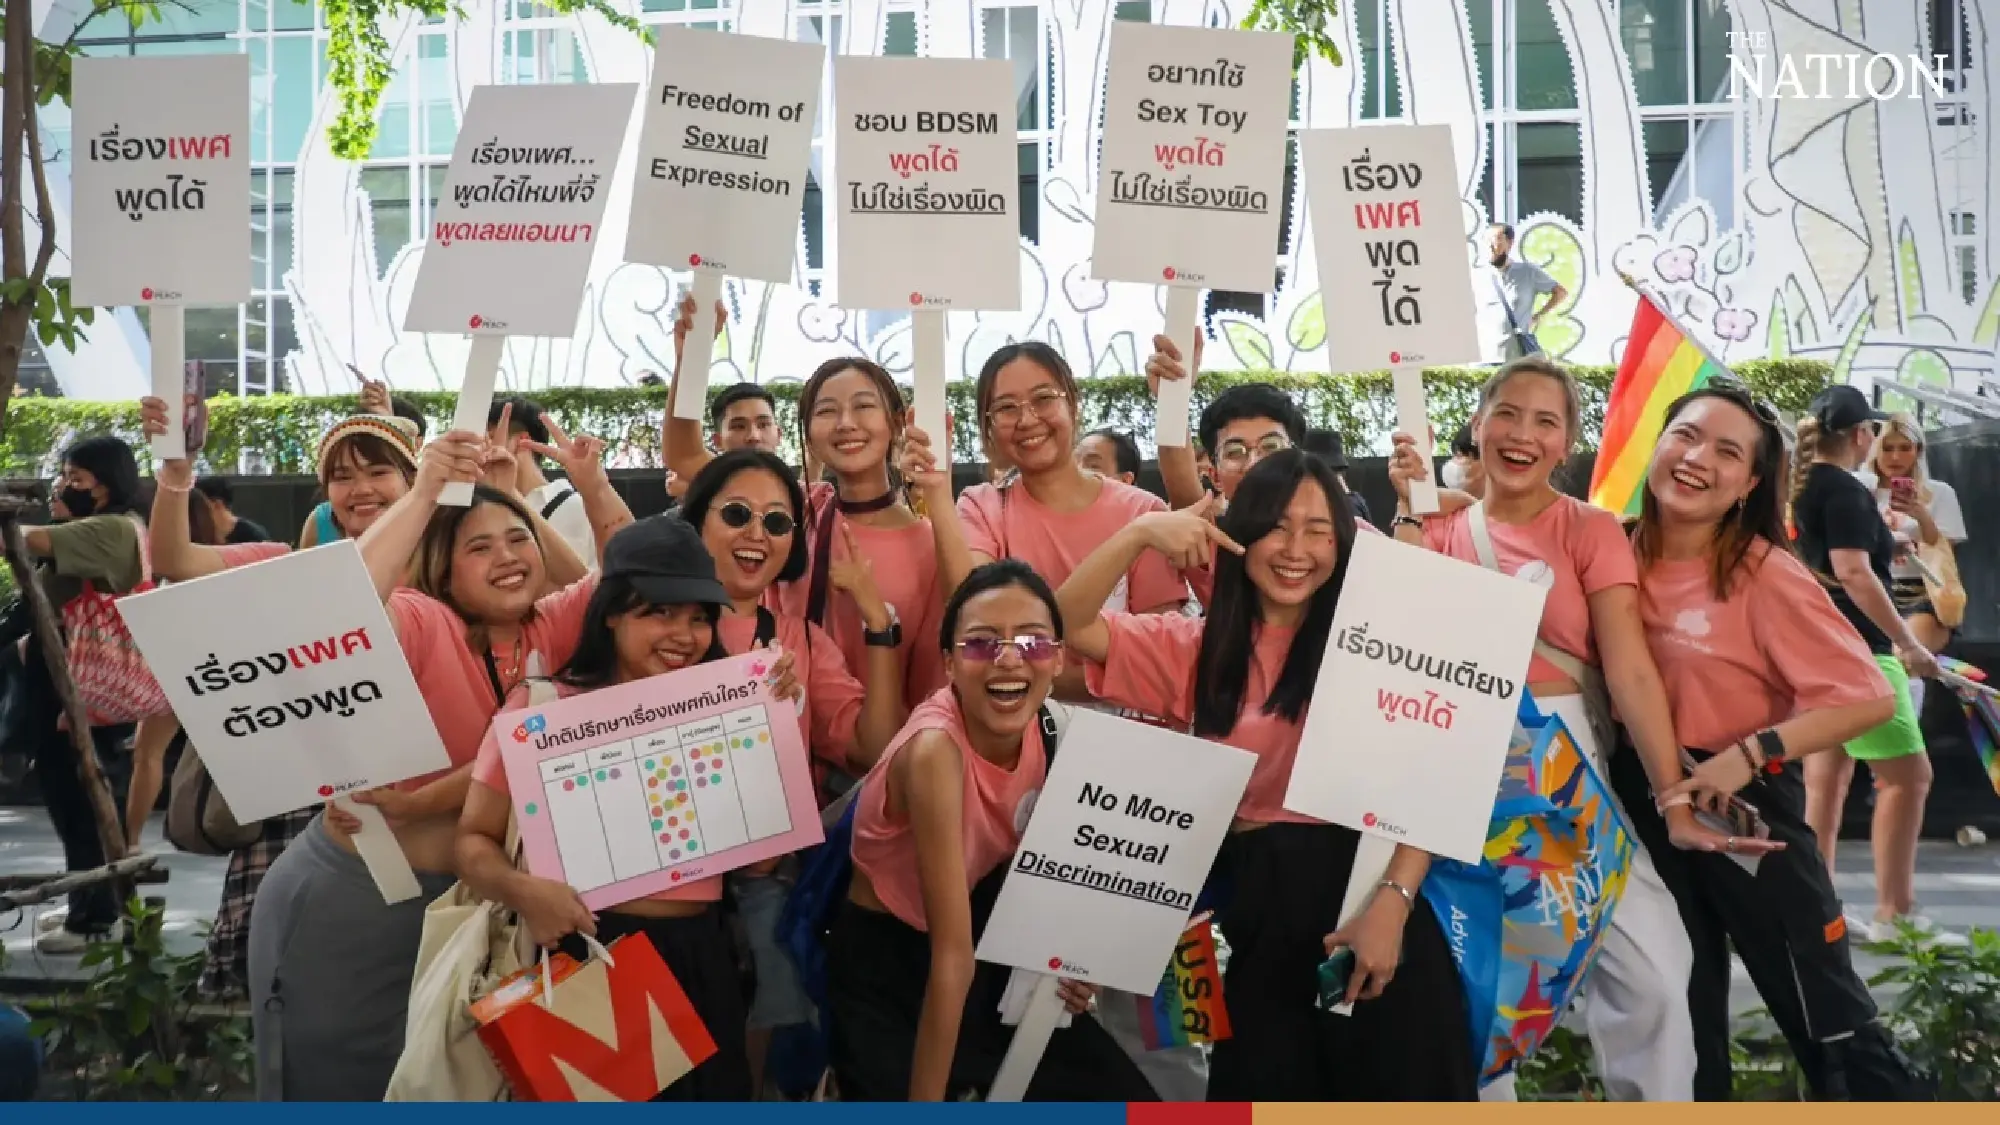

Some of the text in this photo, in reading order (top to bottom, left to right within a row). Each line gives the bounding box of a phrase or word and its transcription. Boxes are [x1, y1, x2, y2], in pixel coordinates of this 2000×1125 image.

[1147, 57, 1247, 89] อยากใช้
[661, 84, 806, 123] Freedom of
[854, 111, 999, 135] ชอบ BDSM
[1137, 98, 1248, 133] Sex Toy
[89, 124, 232, 162] เรื่องเพศ
[683, 125, 769, 158] Sexual
[1154, 136, 1226, 171] พูดได้
[650, 158, 790, 197] Expression
[889, 144, 959, 179] พูดได้
[1342, 147, 1422, 193] เรื่อง
[115, 174, 207, 222] พูดได้
[453, 172, 600, 211] พูดได้ไหมพี่จี้
[848, 181, 1006, 213] ไม่ใช่เรื่องผิด
[1110, 170, 1269, 214] ไม่ใช่เรื่องผิด
[435, 218, 593, 248] พูดเลยแอนนา
[1354, 199, 1421, 230] เพศ
[1364, 238, 1421, 279] พูด
[1372, 279, 1422, 328] ได้
[185, 627, 373, 697] เรื่องเพศ
[1336, 622, 1515, 701] เรื่องบนเตียง
[223, 680, 383, 737] ต้องพูด
[1377, 687, 1459, 731] พูดได้
[1077, 782, 1195, 831] No More
[1073, 824, 1170, 866] Sexual
[1377, 821, 1408, 837] PEACH
[1016, 850, 1194, 909] Discrimination
